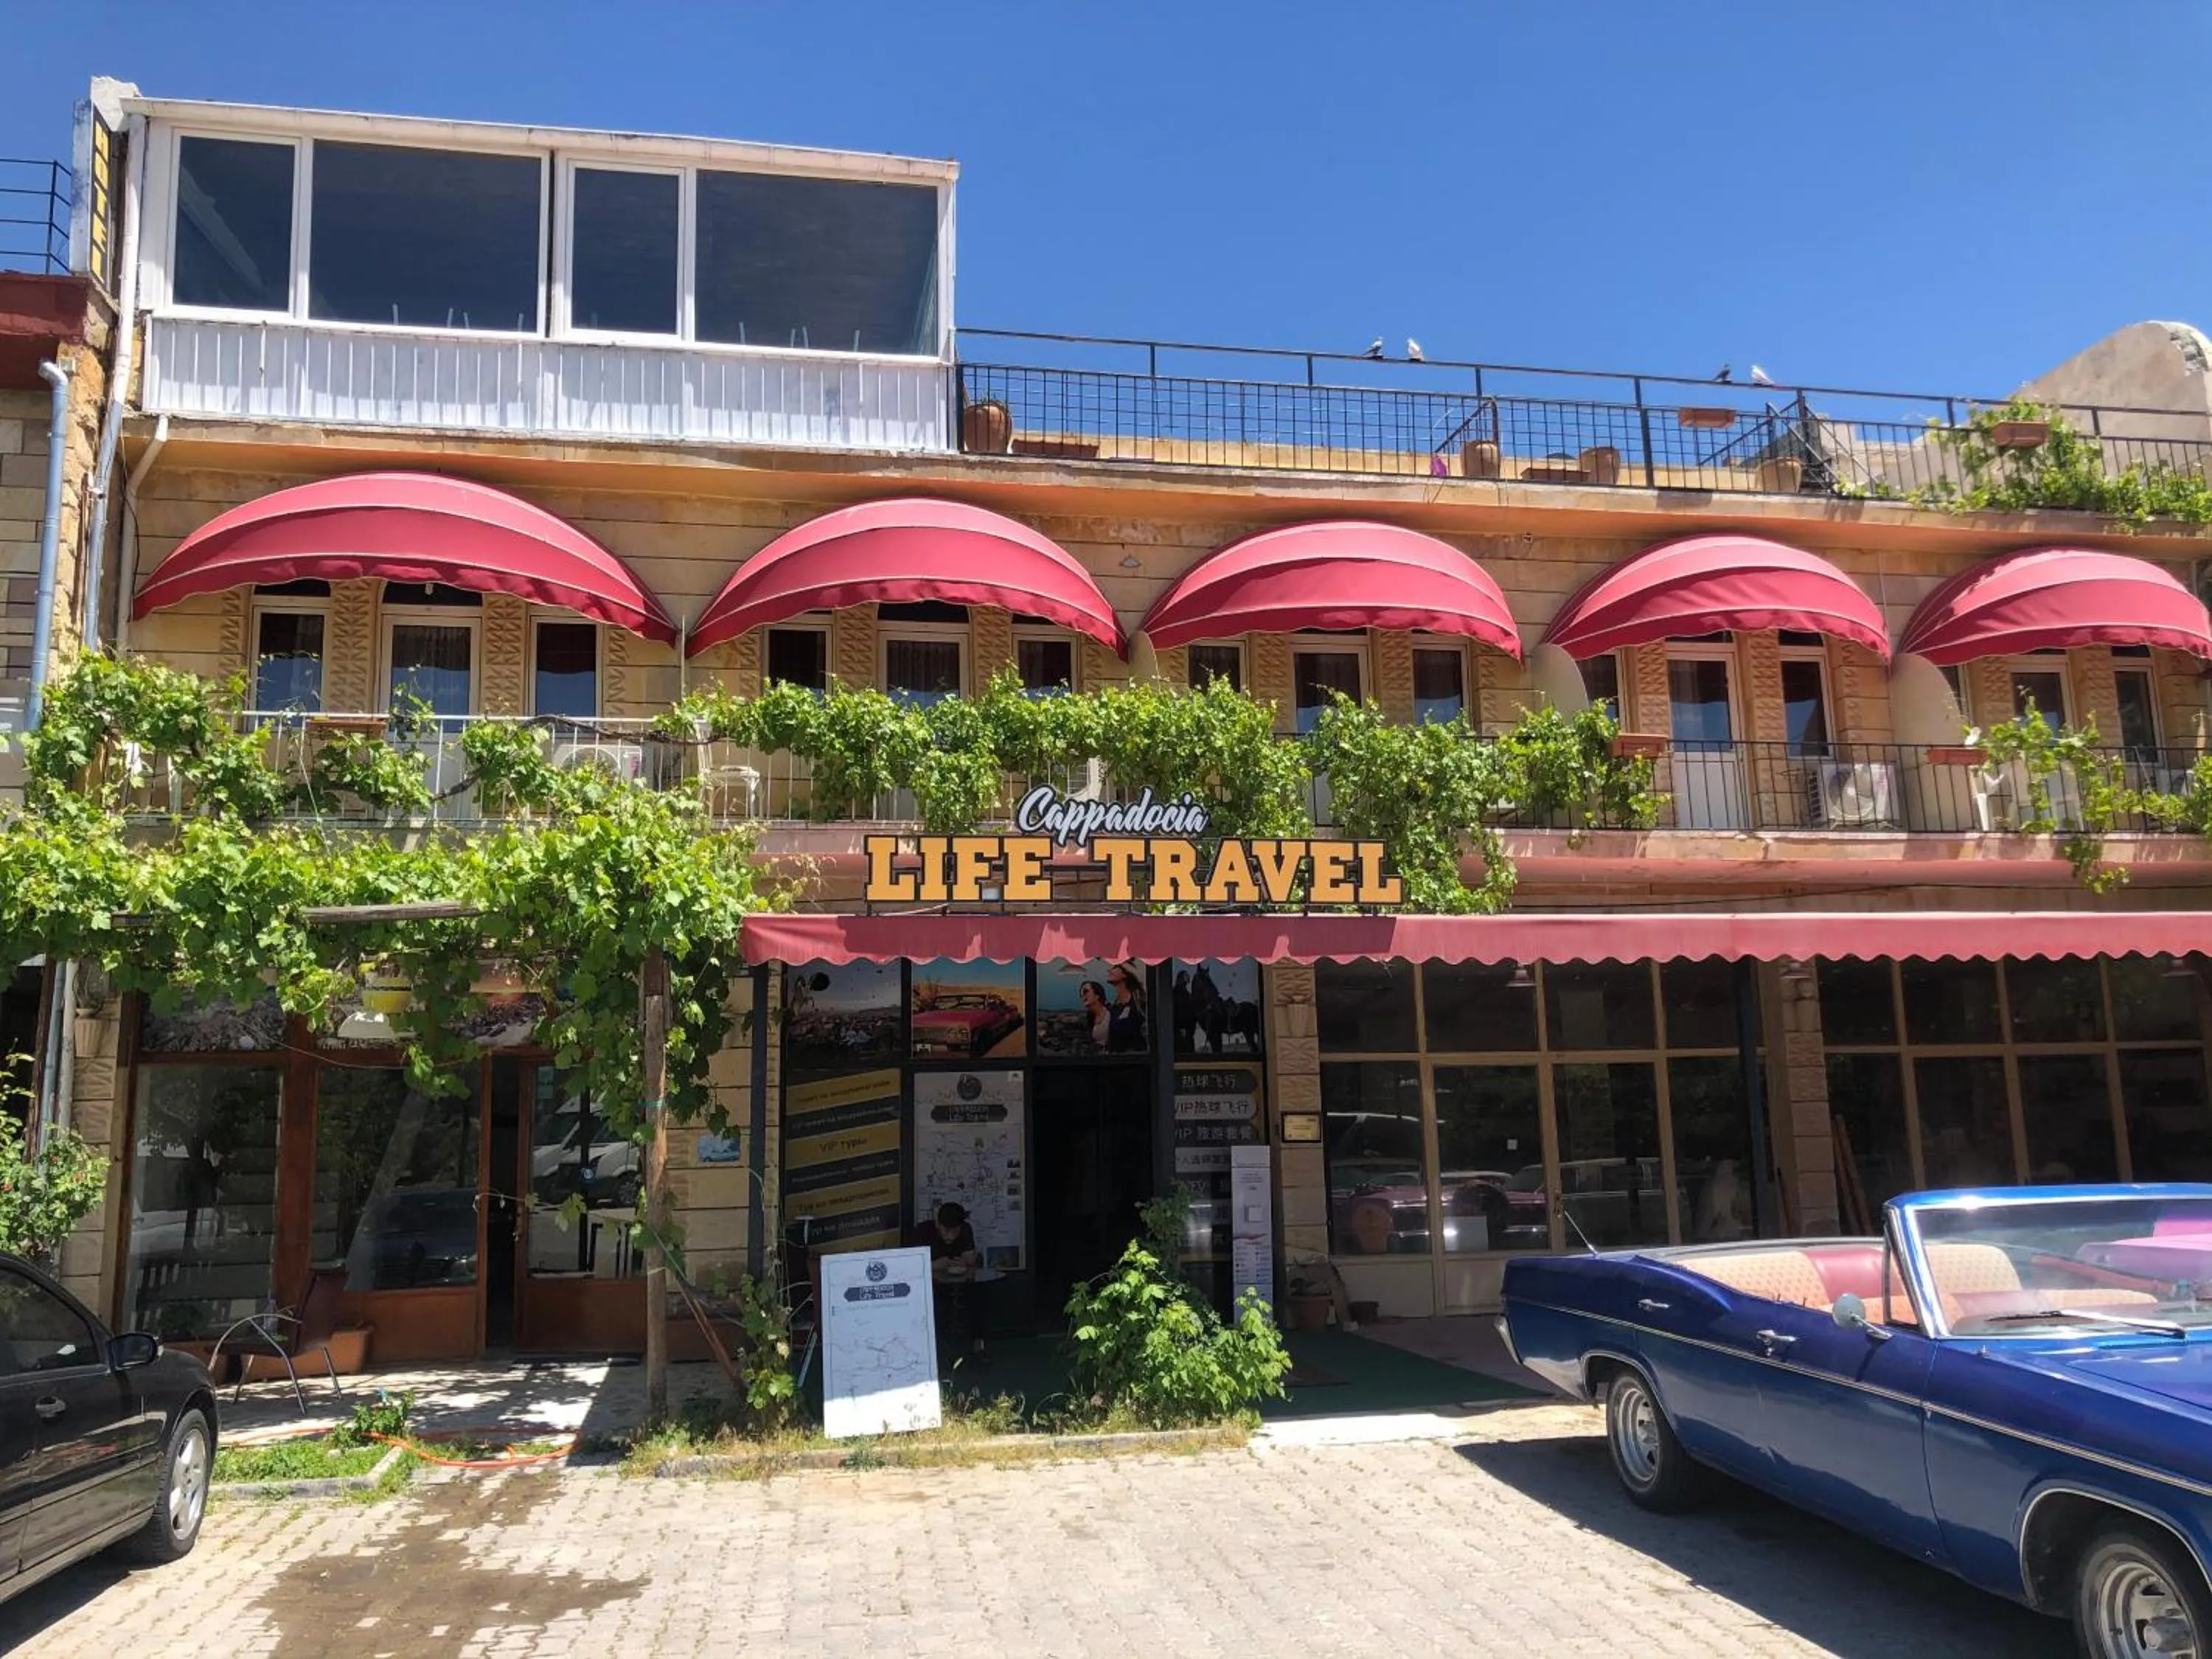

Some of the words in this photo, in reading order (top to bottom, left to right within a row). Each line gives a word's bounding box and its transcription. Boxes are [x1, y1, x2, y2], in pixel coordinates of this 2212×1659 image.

[91, 120, 109, 284] HOTEL
[1018, 784, 1209, 846] Cappadocia
[866, 835, 1053, 902] LIFE
[1092, 837, 1403, 904] TRAVEL
